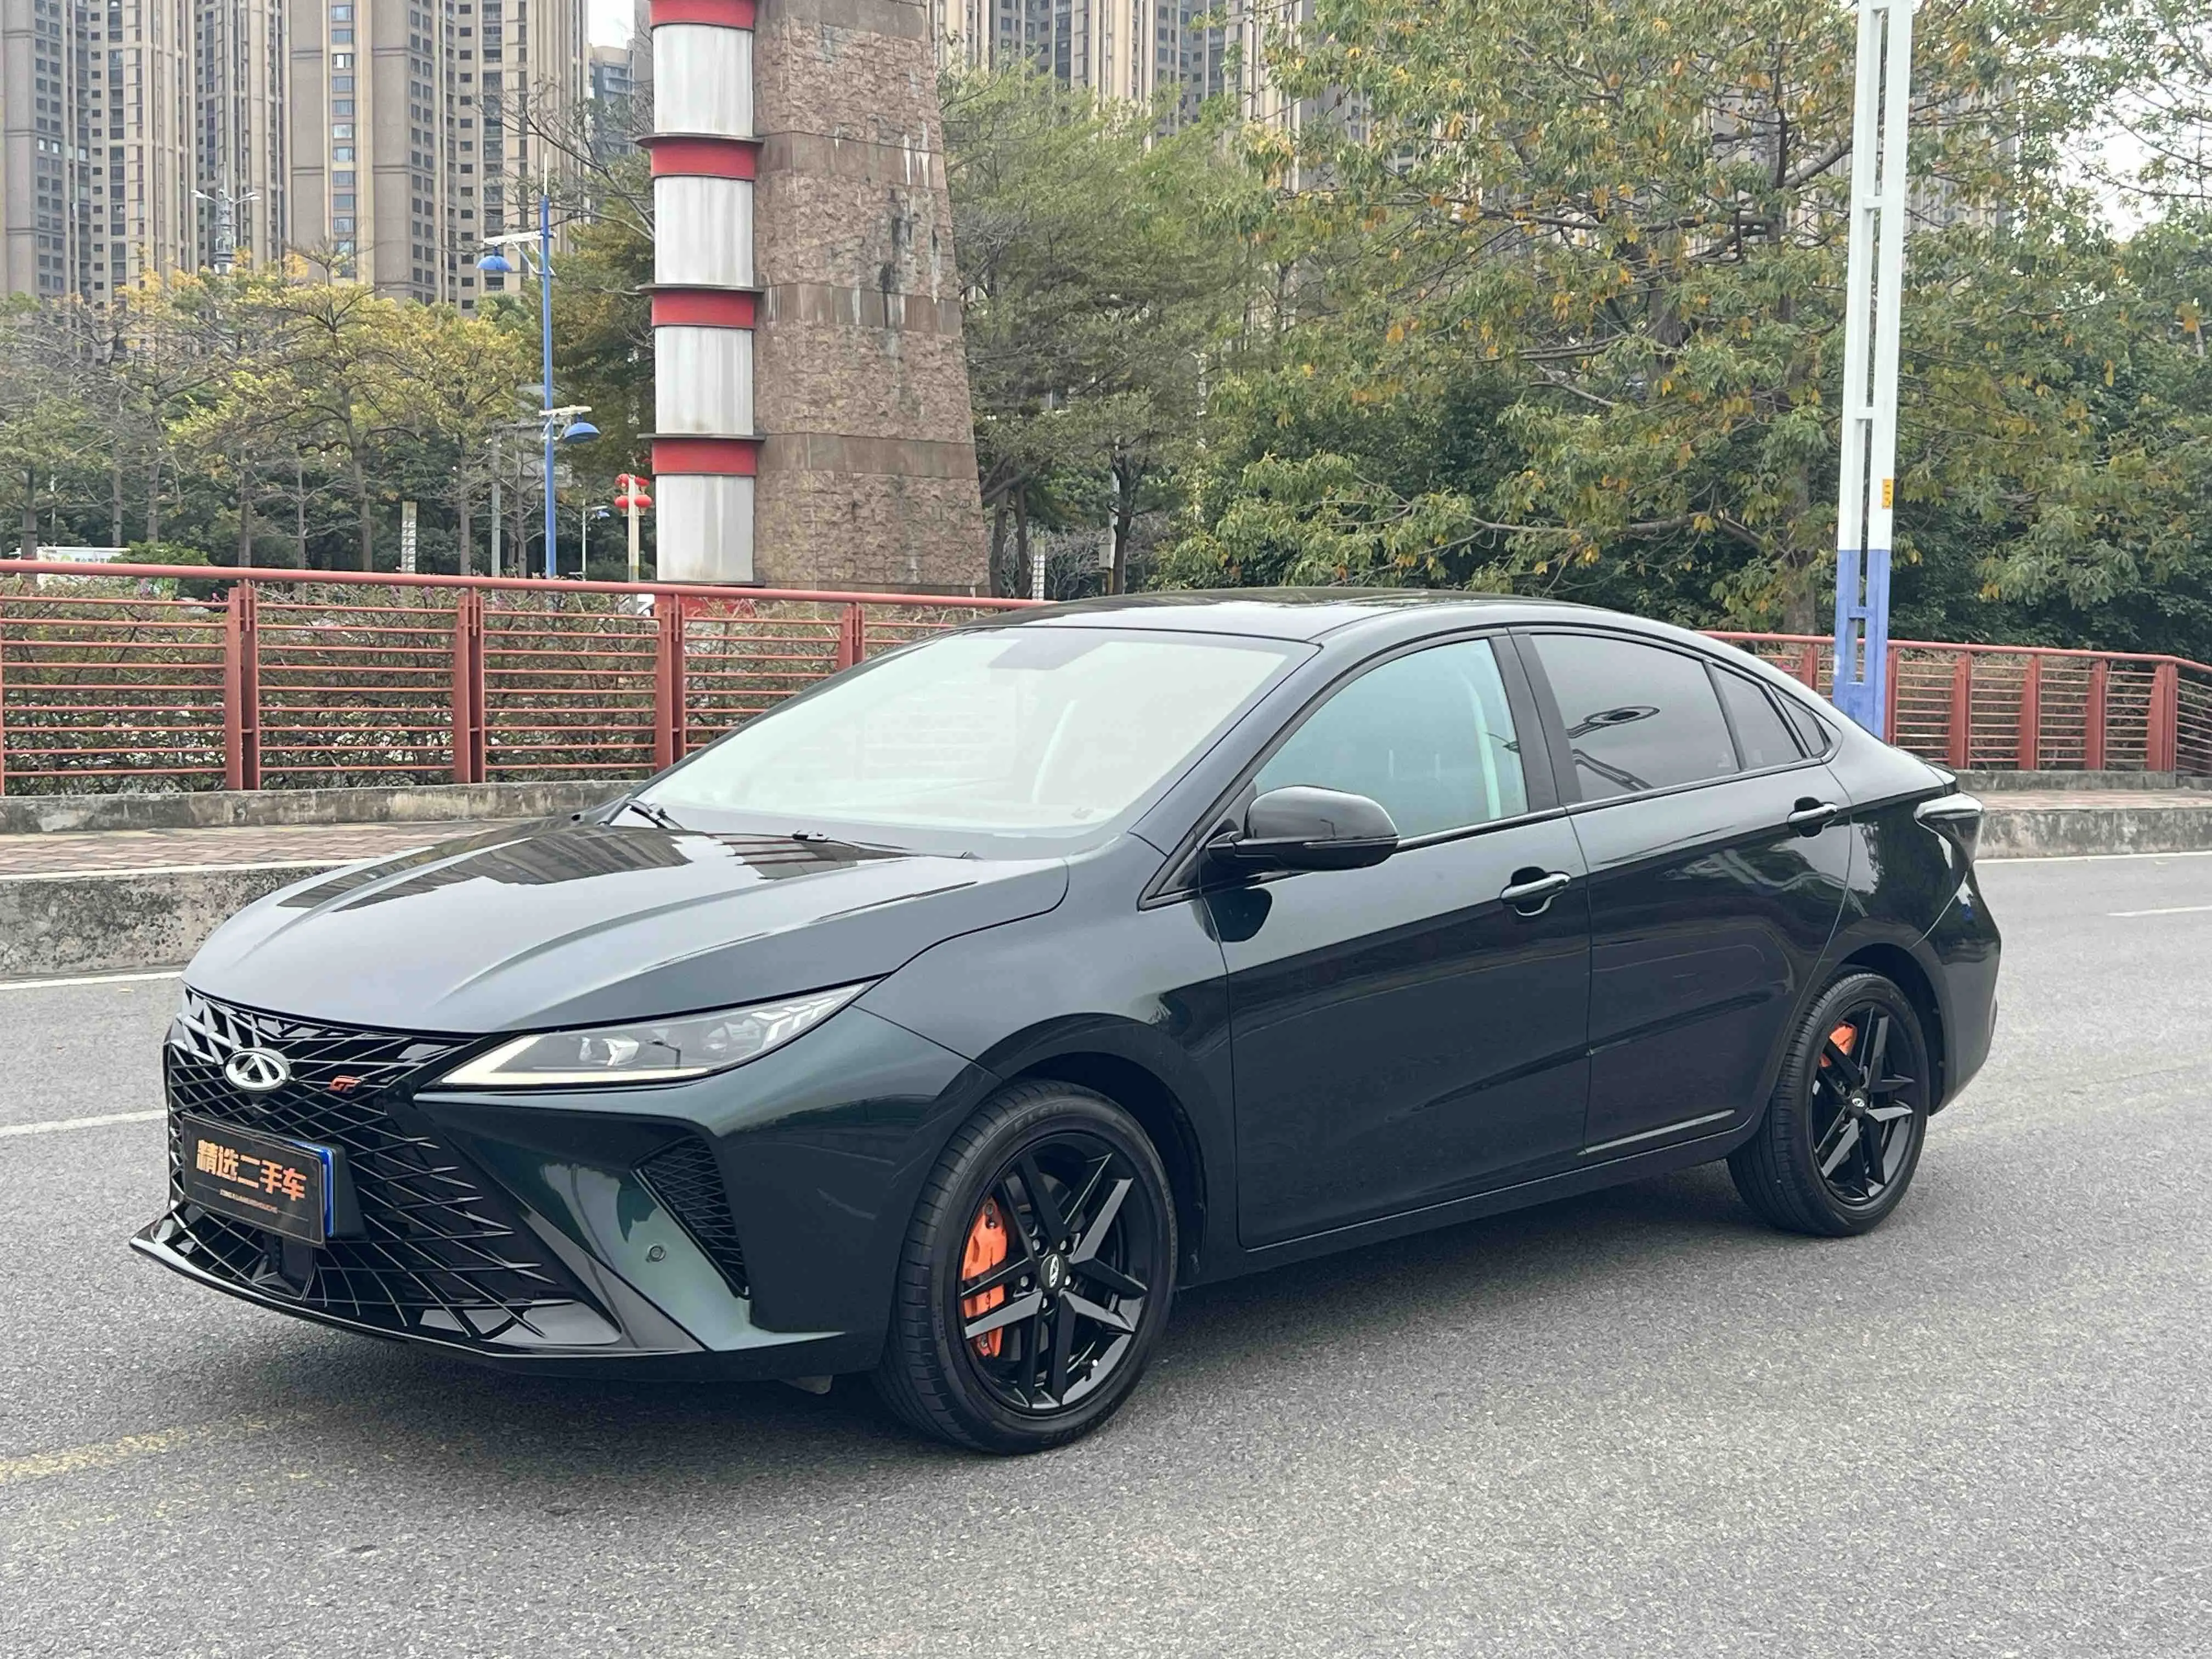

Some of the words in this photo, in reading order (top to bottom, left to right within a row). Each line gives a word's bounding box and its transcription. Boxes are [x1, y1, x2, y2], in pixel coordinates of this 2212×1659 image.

[196, 1139, 307, 1201] 精选二手车
